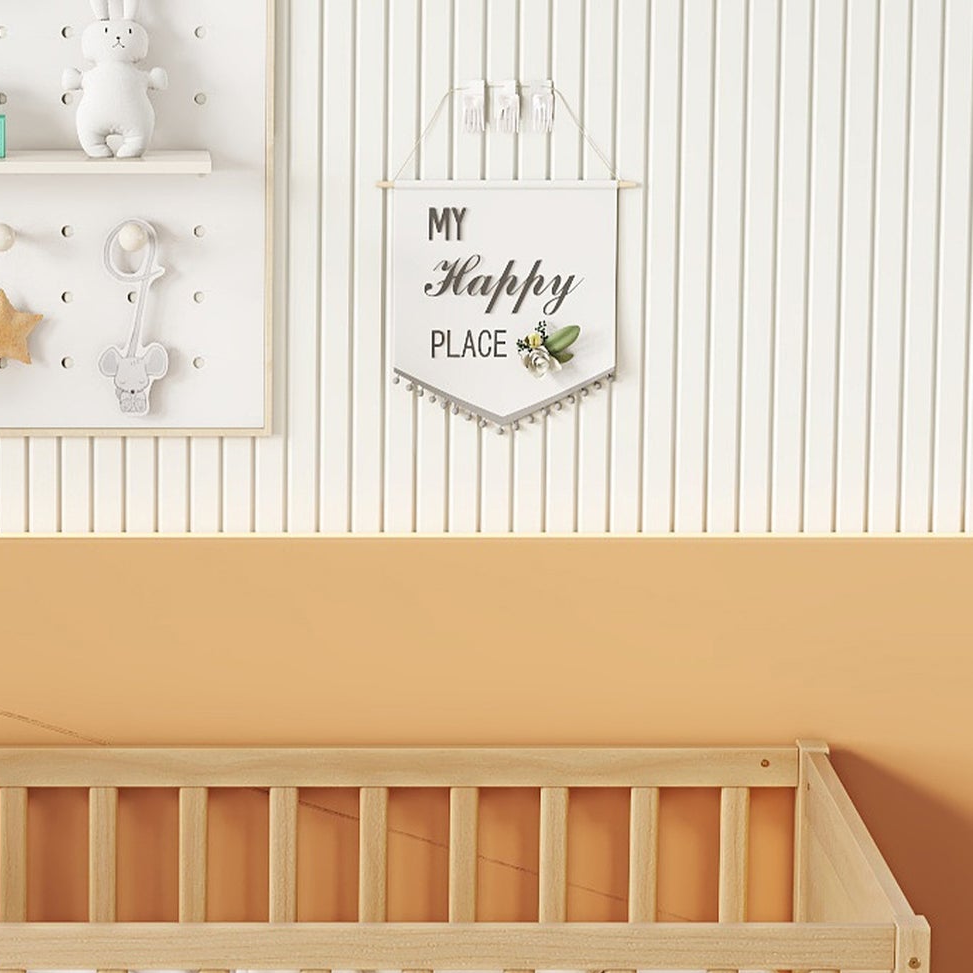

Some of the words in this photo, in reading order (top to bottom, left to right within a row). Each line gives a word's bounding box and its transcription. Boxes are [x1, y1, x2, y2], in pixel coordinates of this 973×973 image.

[428, 207, 467, 241] MY
[424, 254, 584, 315] Happy
[431, 330, 508, 358] PLACE
